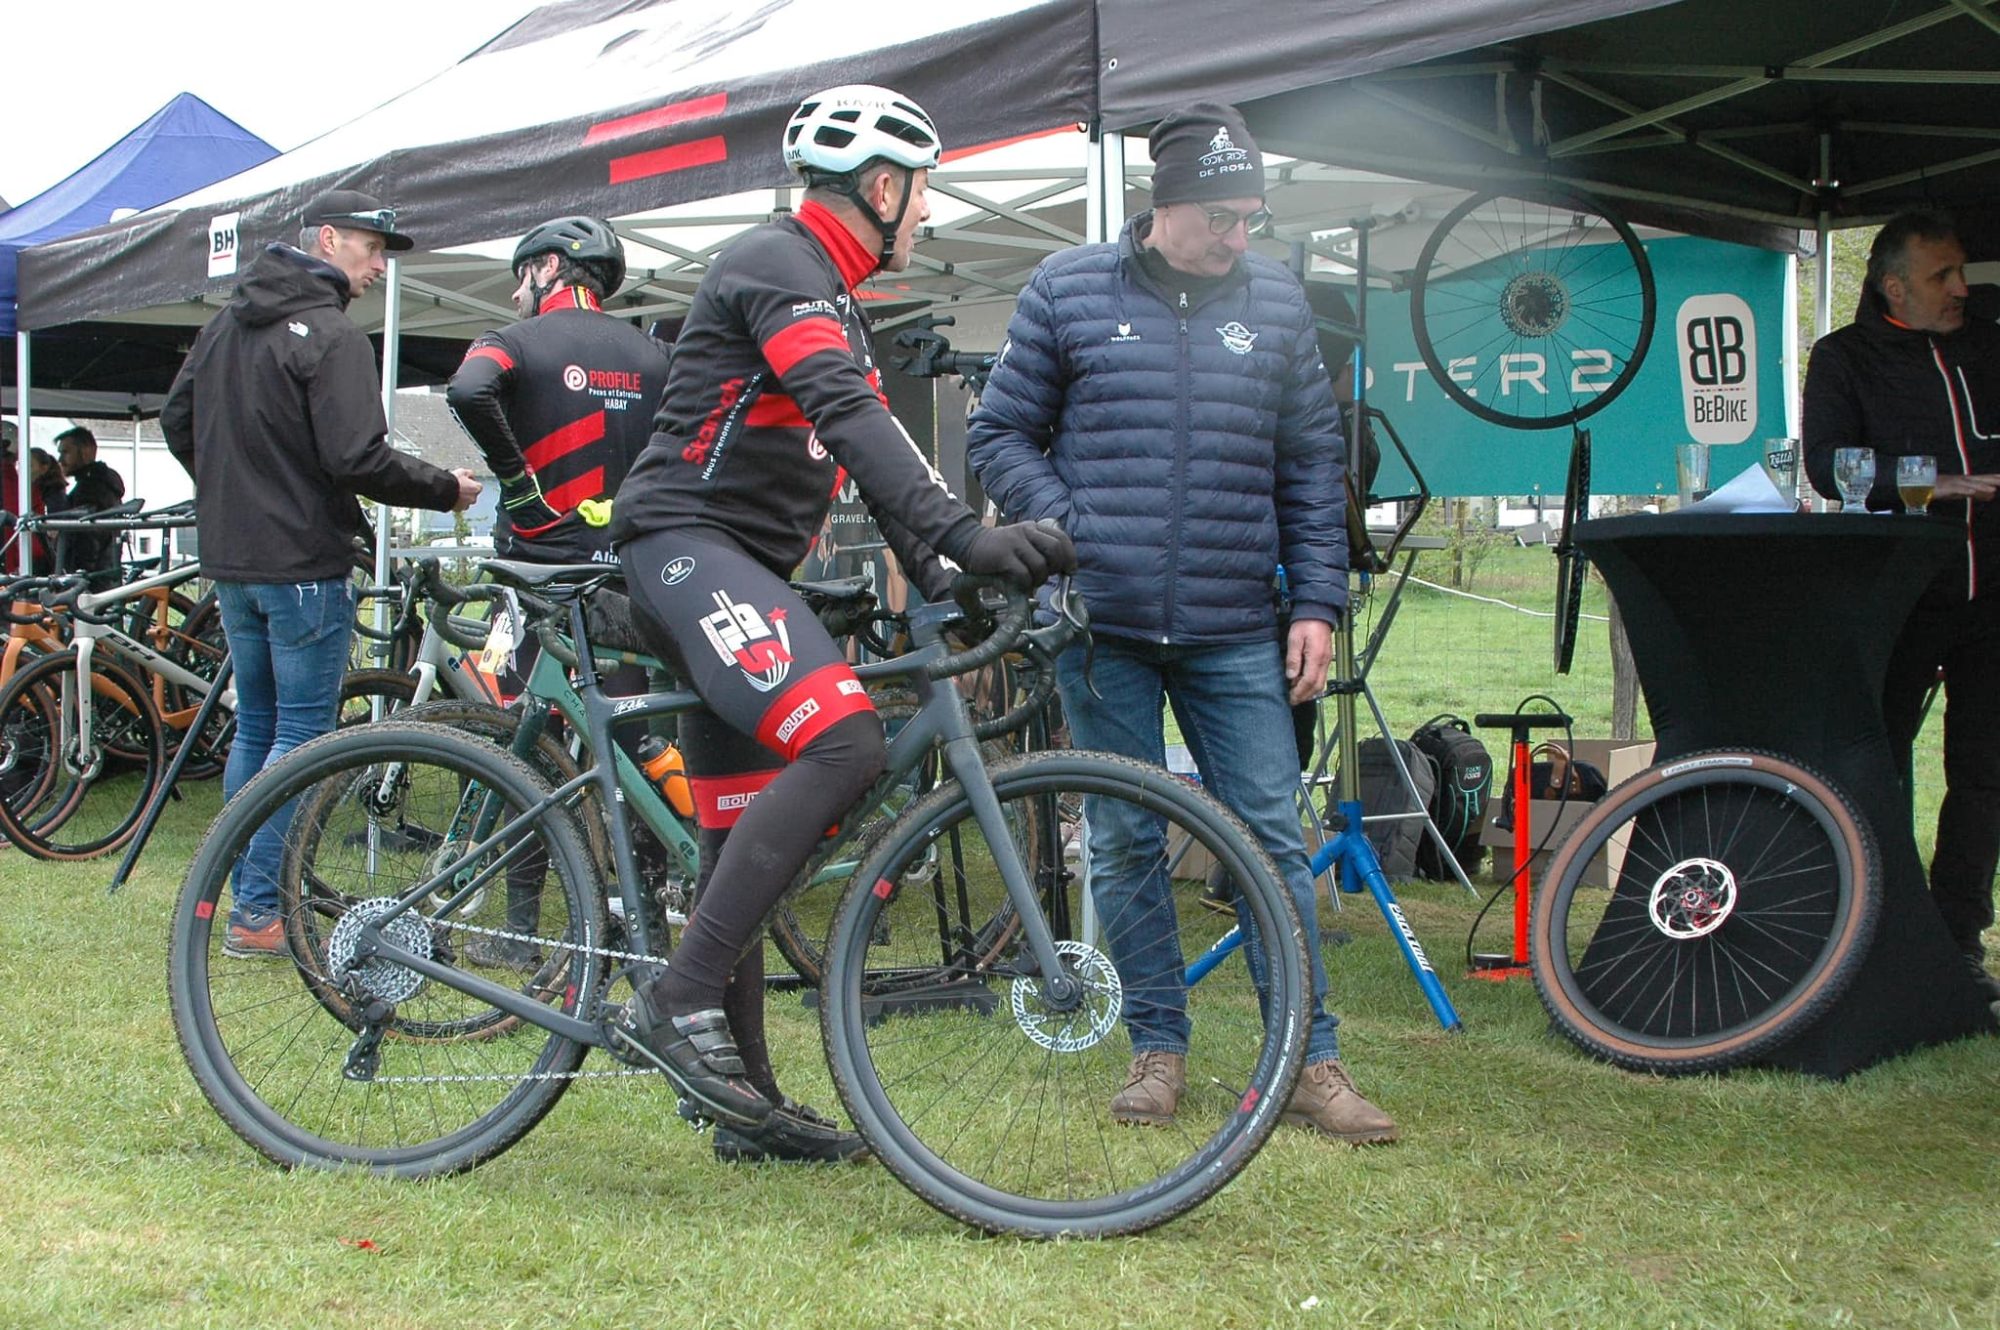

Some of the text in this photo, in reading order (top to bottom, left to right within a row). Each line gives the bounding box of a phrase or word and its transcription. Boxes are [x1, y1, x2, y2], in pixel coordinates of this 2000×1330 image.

[1199, 163, 1253, 178] DE ROSA
[213, 229, 235, 253] BH
[588, 369, 641, 391] PROFILE
[604, 399, 628, 411] HABAY
[702, 458, 716, 480] Nous
[713, 421, 732, 457] prenons
[831, 514, 866, 524] GRAVEL
[778, 700, 818, 741] BOUVY
[719, 793, 755, 808] BOU
